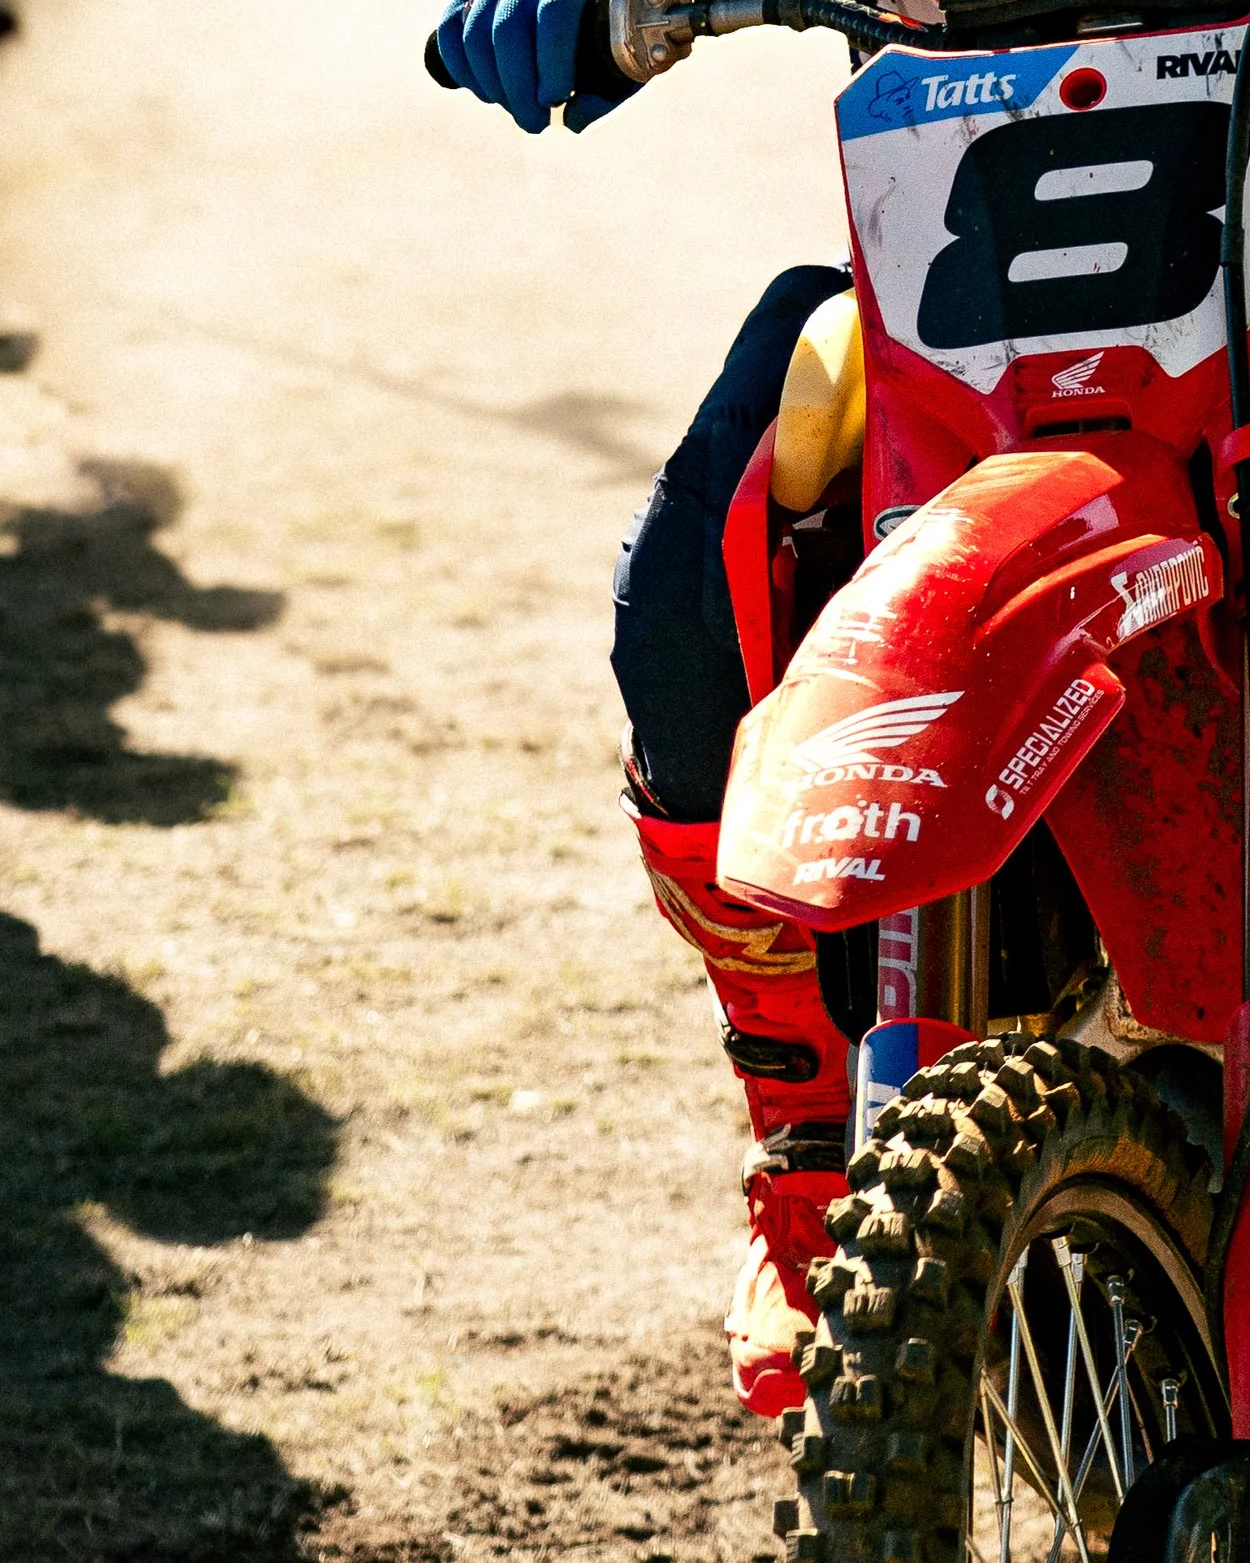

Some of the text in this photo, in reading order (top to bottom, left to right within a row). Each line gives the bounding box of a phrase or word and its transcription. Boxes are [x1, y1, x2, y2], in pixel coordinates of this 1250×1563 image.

[921, 73, 1016, 112] Tatts
[1051, 385, 1106, 398] HONDA
[998, 678, 1096, 790] SPECIALIZED
[1031, 762, 1049, 781] TRAY
[1046, 746, 1061, 763] AND
[1058, 721, 1082, 747] TOWING
[1078, 689, 1105, 722] SERVICES
[784, 763, 948, 794] HONDA
[783, 801, 921, 849] froth
[793, 856, 886, 886] RIVAL
